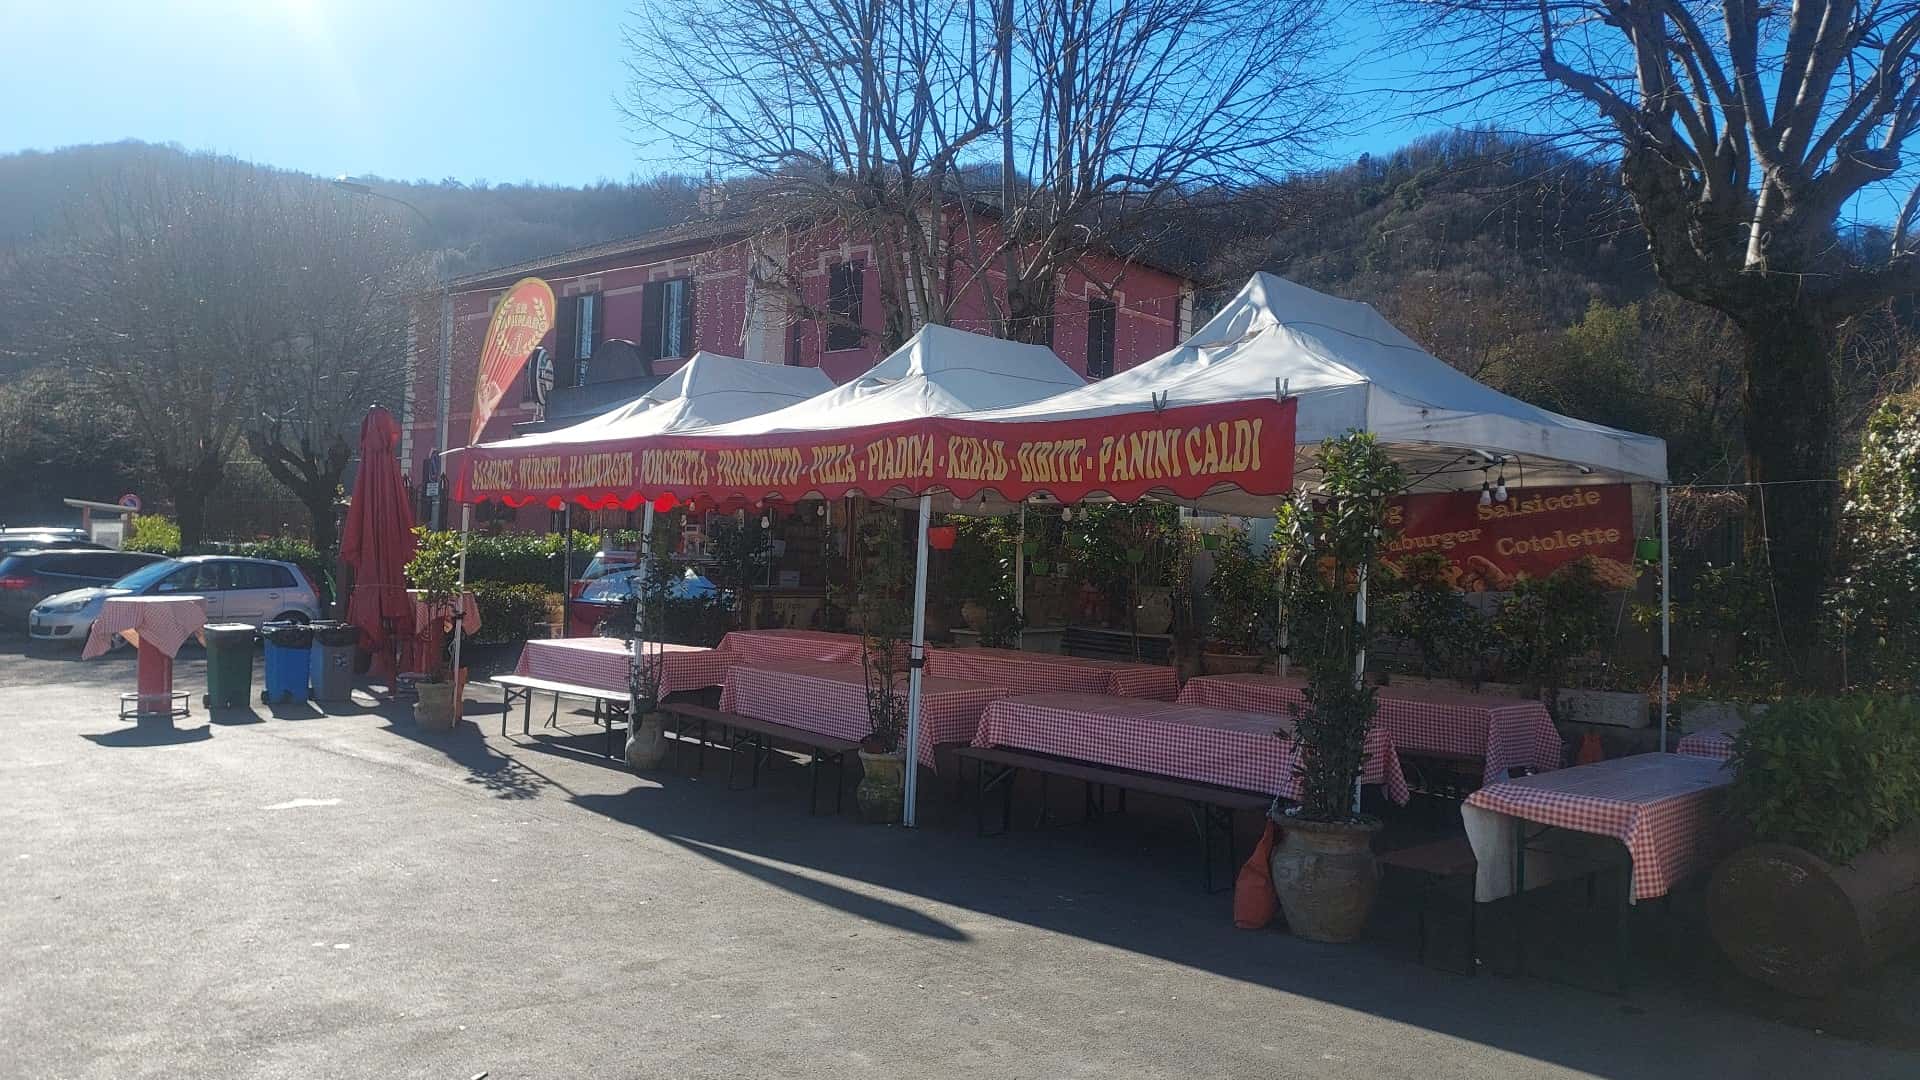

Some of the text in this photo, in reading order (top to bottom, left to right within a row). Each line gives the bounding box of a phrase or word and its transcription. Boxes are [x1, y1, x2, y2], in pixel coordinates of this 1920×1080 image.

[519, 453, 563, 490] WÜRSTEL
[569, 451, 633, 488] HAMBURGER
[640, 448, 708, 486] PORCHETTA
[717, 447, 801, 487] PROSCIUTTO
[810, 444, 858, 484] PIZZA
[947, 436, 1009, 481] KEBAB
[1018, 438, 1087, 482] BIBITE
[1099, 428, 1182, 481] PANINI
[1185, 418, 1263, 475] CALDI
[1477, 487, 1601, 521] Salsiccie
[1495, 526, 1622, 556] Cotolette
